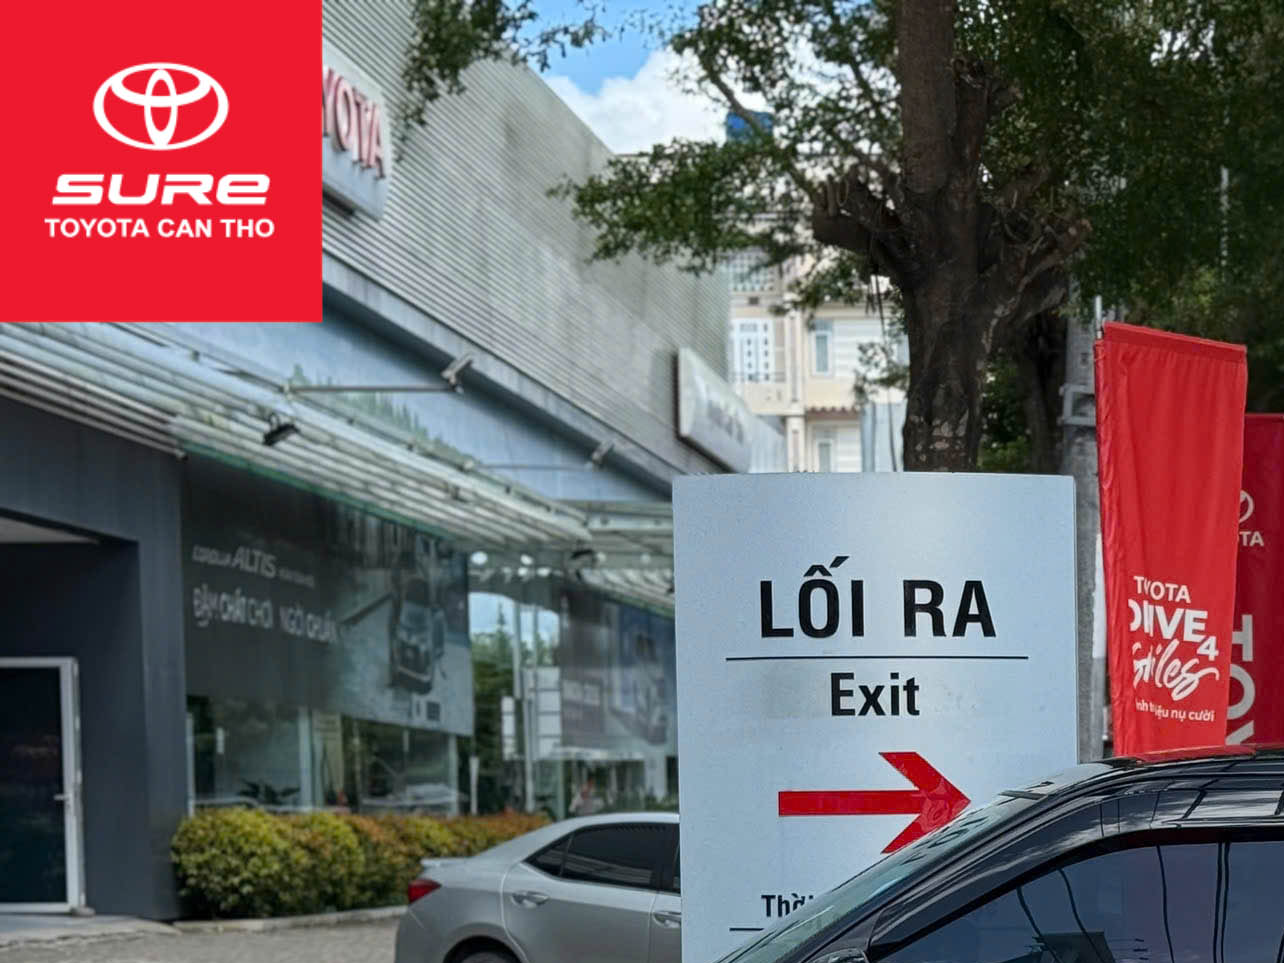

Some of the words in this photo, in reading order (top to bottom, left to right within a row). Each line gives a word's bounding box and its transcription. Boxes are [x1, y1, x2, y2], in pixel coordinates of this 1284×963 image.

[231, 546, 278, 579] ALTIS
[759, 555, 865, 638] LỐI
[903, 579, 997, 638] RA
[1196, 635, 1219, 662] 4
[830, 672, 920, 717] Exit
[760, 892, 814, 918] Thờ
